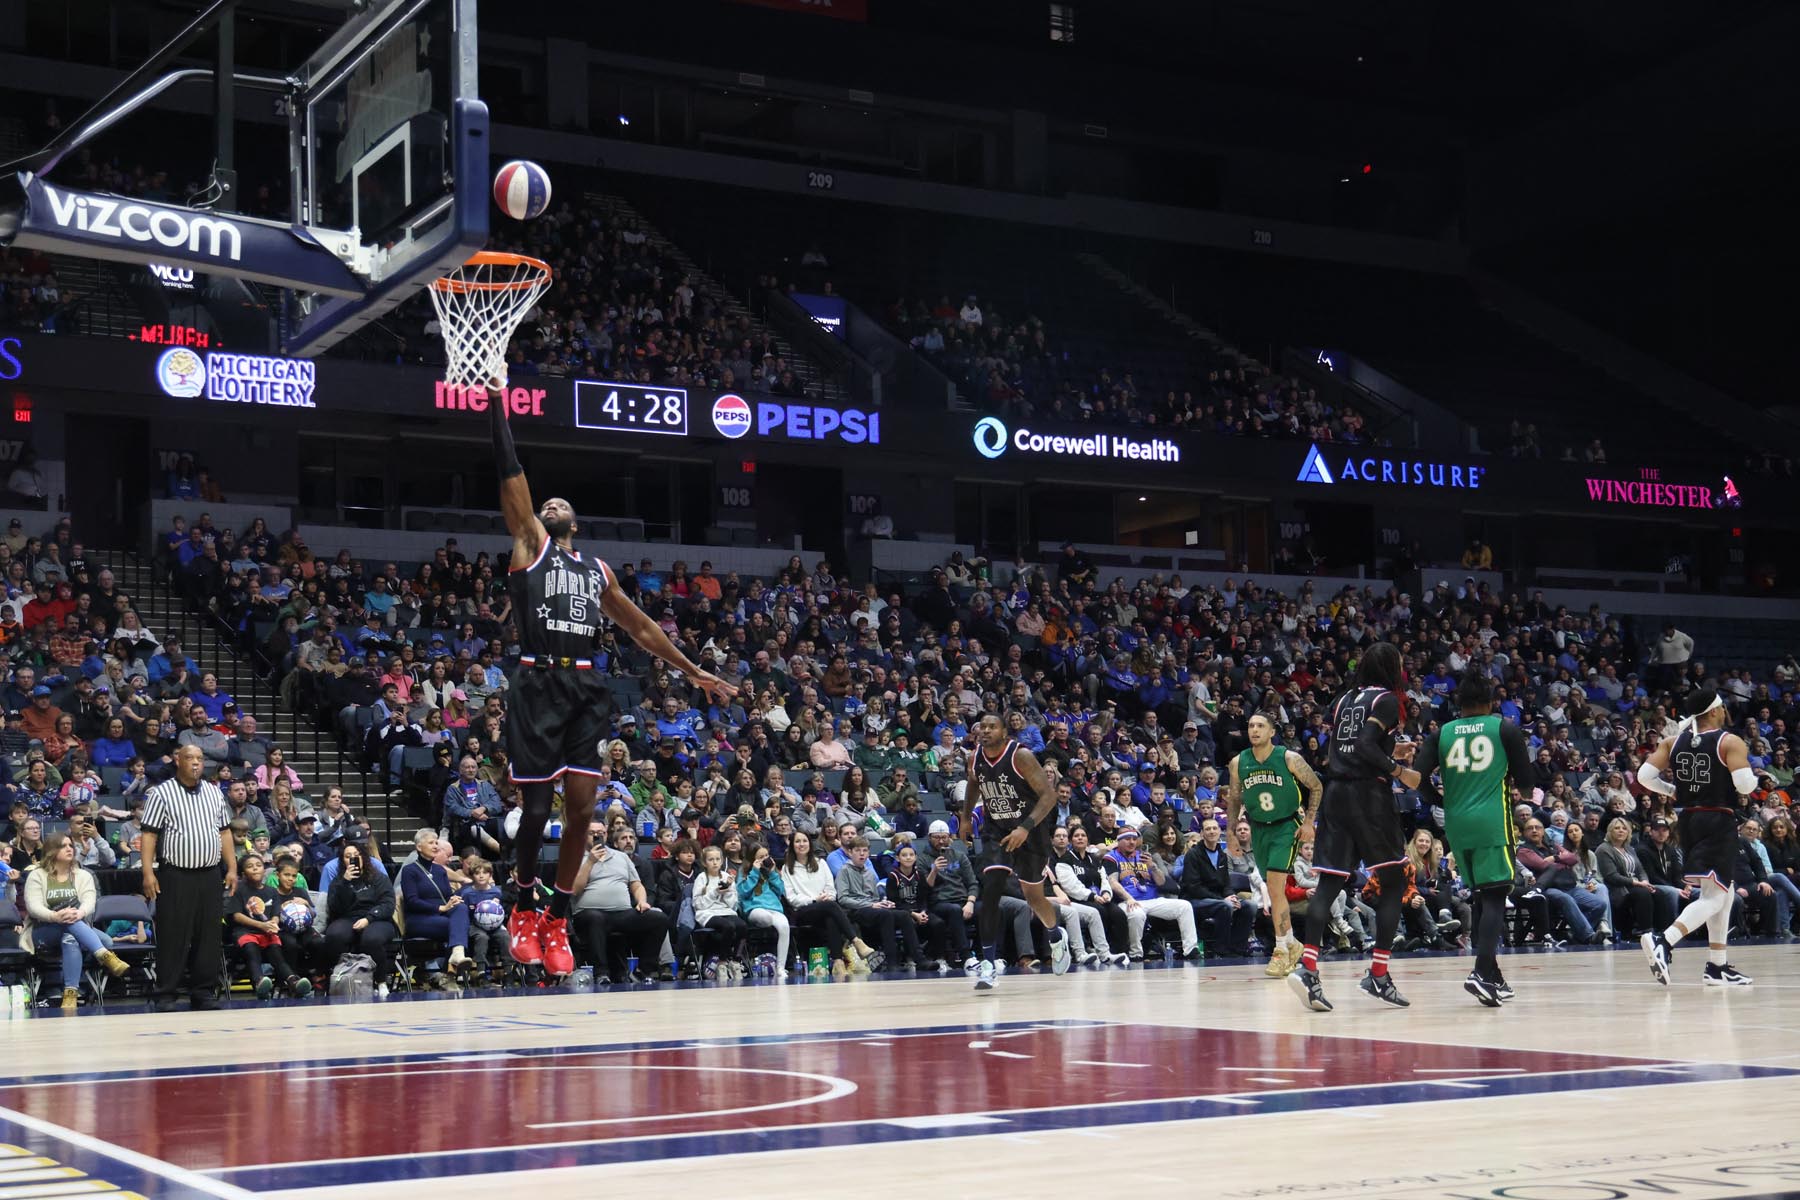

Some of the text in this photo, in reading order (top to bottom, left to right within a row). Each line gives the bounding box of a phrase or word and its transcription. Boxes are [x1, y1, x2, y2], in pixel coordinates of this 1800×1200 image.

[808, 172, 833, 188] 209
[207, 353, 317, 383] MICHIGAN
[207, 373, 317, 407] LOTTERY
[435, 380, 547, 418] mejer
[602, 391, 683, 425] 4:28
[715, 411, 749, 422] PEPSI
[757, 402, 880, 444] PEPSI
[1014, 428, 1180, 462] Corewell Health
[1341, 457, 1480, 488] ACRISURE
[1639, 467, 1661, 480] THE
[721, 487, 750, 506] 108
[1585, 478, 1713, 508] WINCHESTER
[1279, 522, 1302, 540] 109
[1381, 528, 1400, 544] 110
[570, 595, 587, 622] 5
[1336, 706, 1365, 741] 28
[1454, 722, 1485, 735] STEWART
[1445, 735, 1495, 773] 49
[1676, 751, 1711, 784] 32
[1243, 774, 1283, 789] GENERALS
[990, 798, 1013, 812] 42
[1258, 791, 1275, 811] 8
